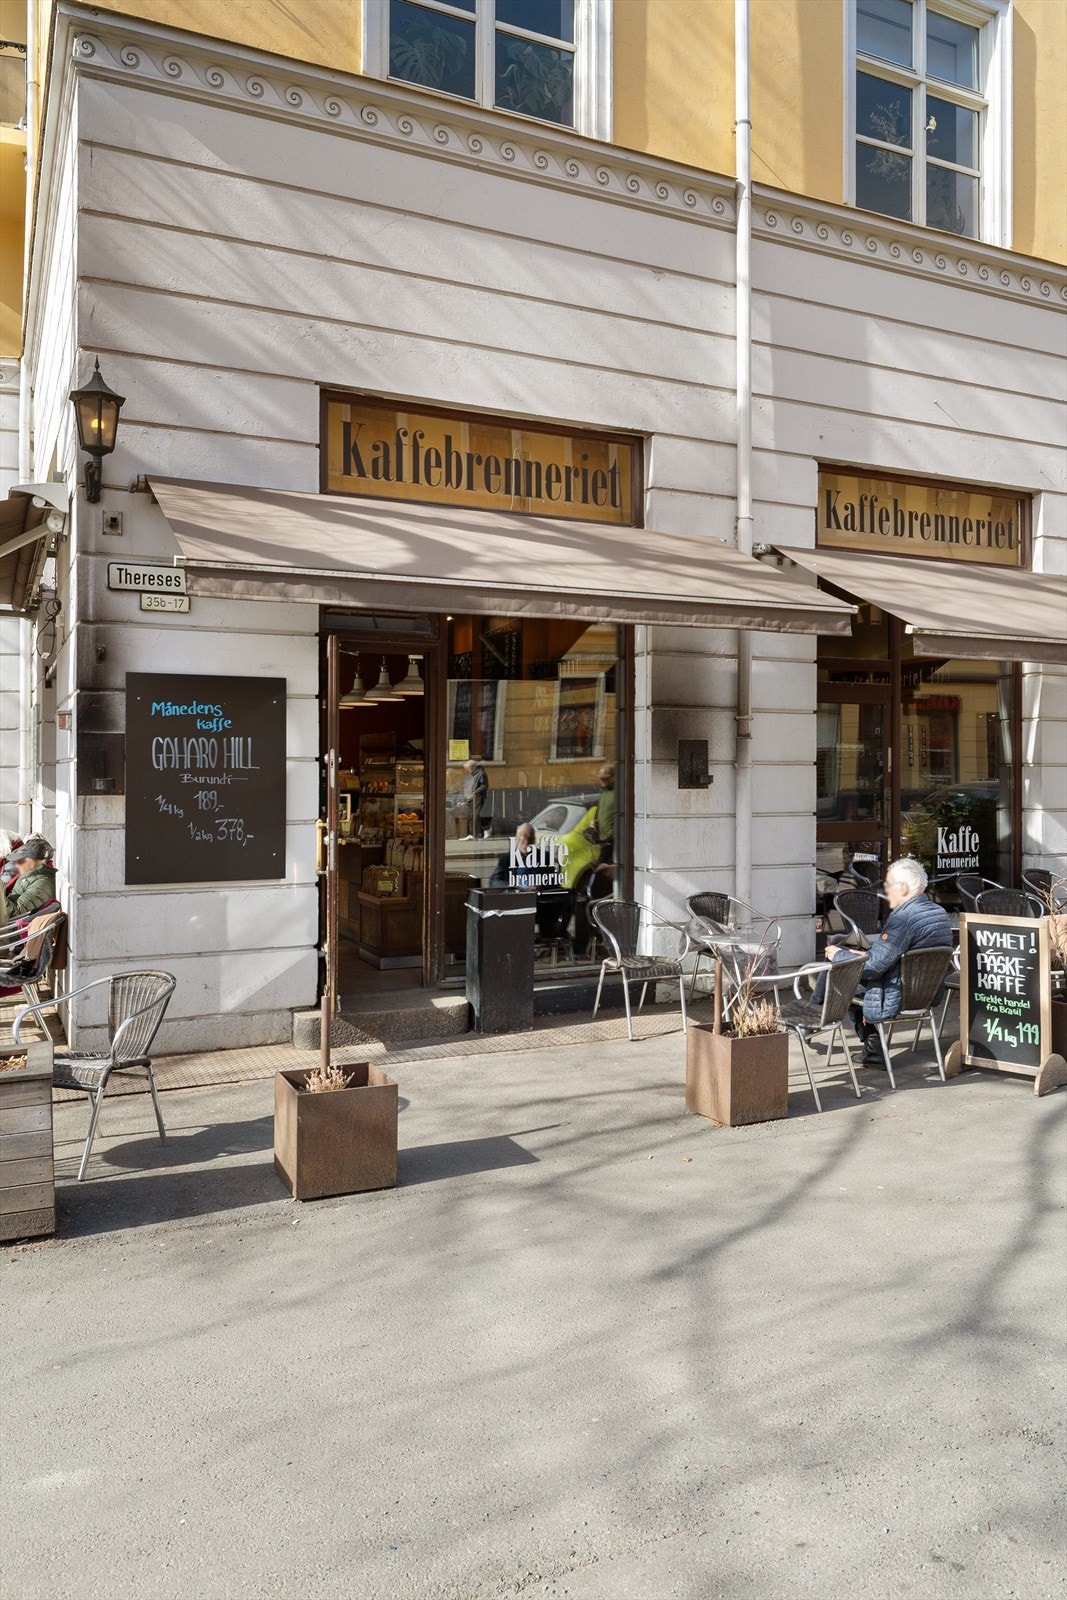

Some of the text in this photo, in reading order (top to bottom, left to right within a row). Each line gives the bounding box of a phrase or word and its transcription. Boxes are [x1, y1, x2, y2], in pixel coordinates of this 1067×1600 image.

[340, 419, 624, 509] Kaffebrenneriet
[824, 489, 1016, 550] Kaffebrenneriet
[116, 567, 181, 588] Thereses
[146, 596, 185, 609] 35b-17
[151, 700, 223, 717] Månedens
[151, 736, 261, 771] GAHARO HILL
[179, 772, 248, 785] Burundi
[937, 825, 980, 854] Kaffe
[508, 834, 569, 869] Kaffe
[937, 854, 980, 869] brenneriet
[508, 869, 569, 887] brenneriet
[977, 972, 1027, 996] KAFFE
[986, 1003, 1022, 1017] fra Brasil
[1004, 997, 1031, 1010] handel
